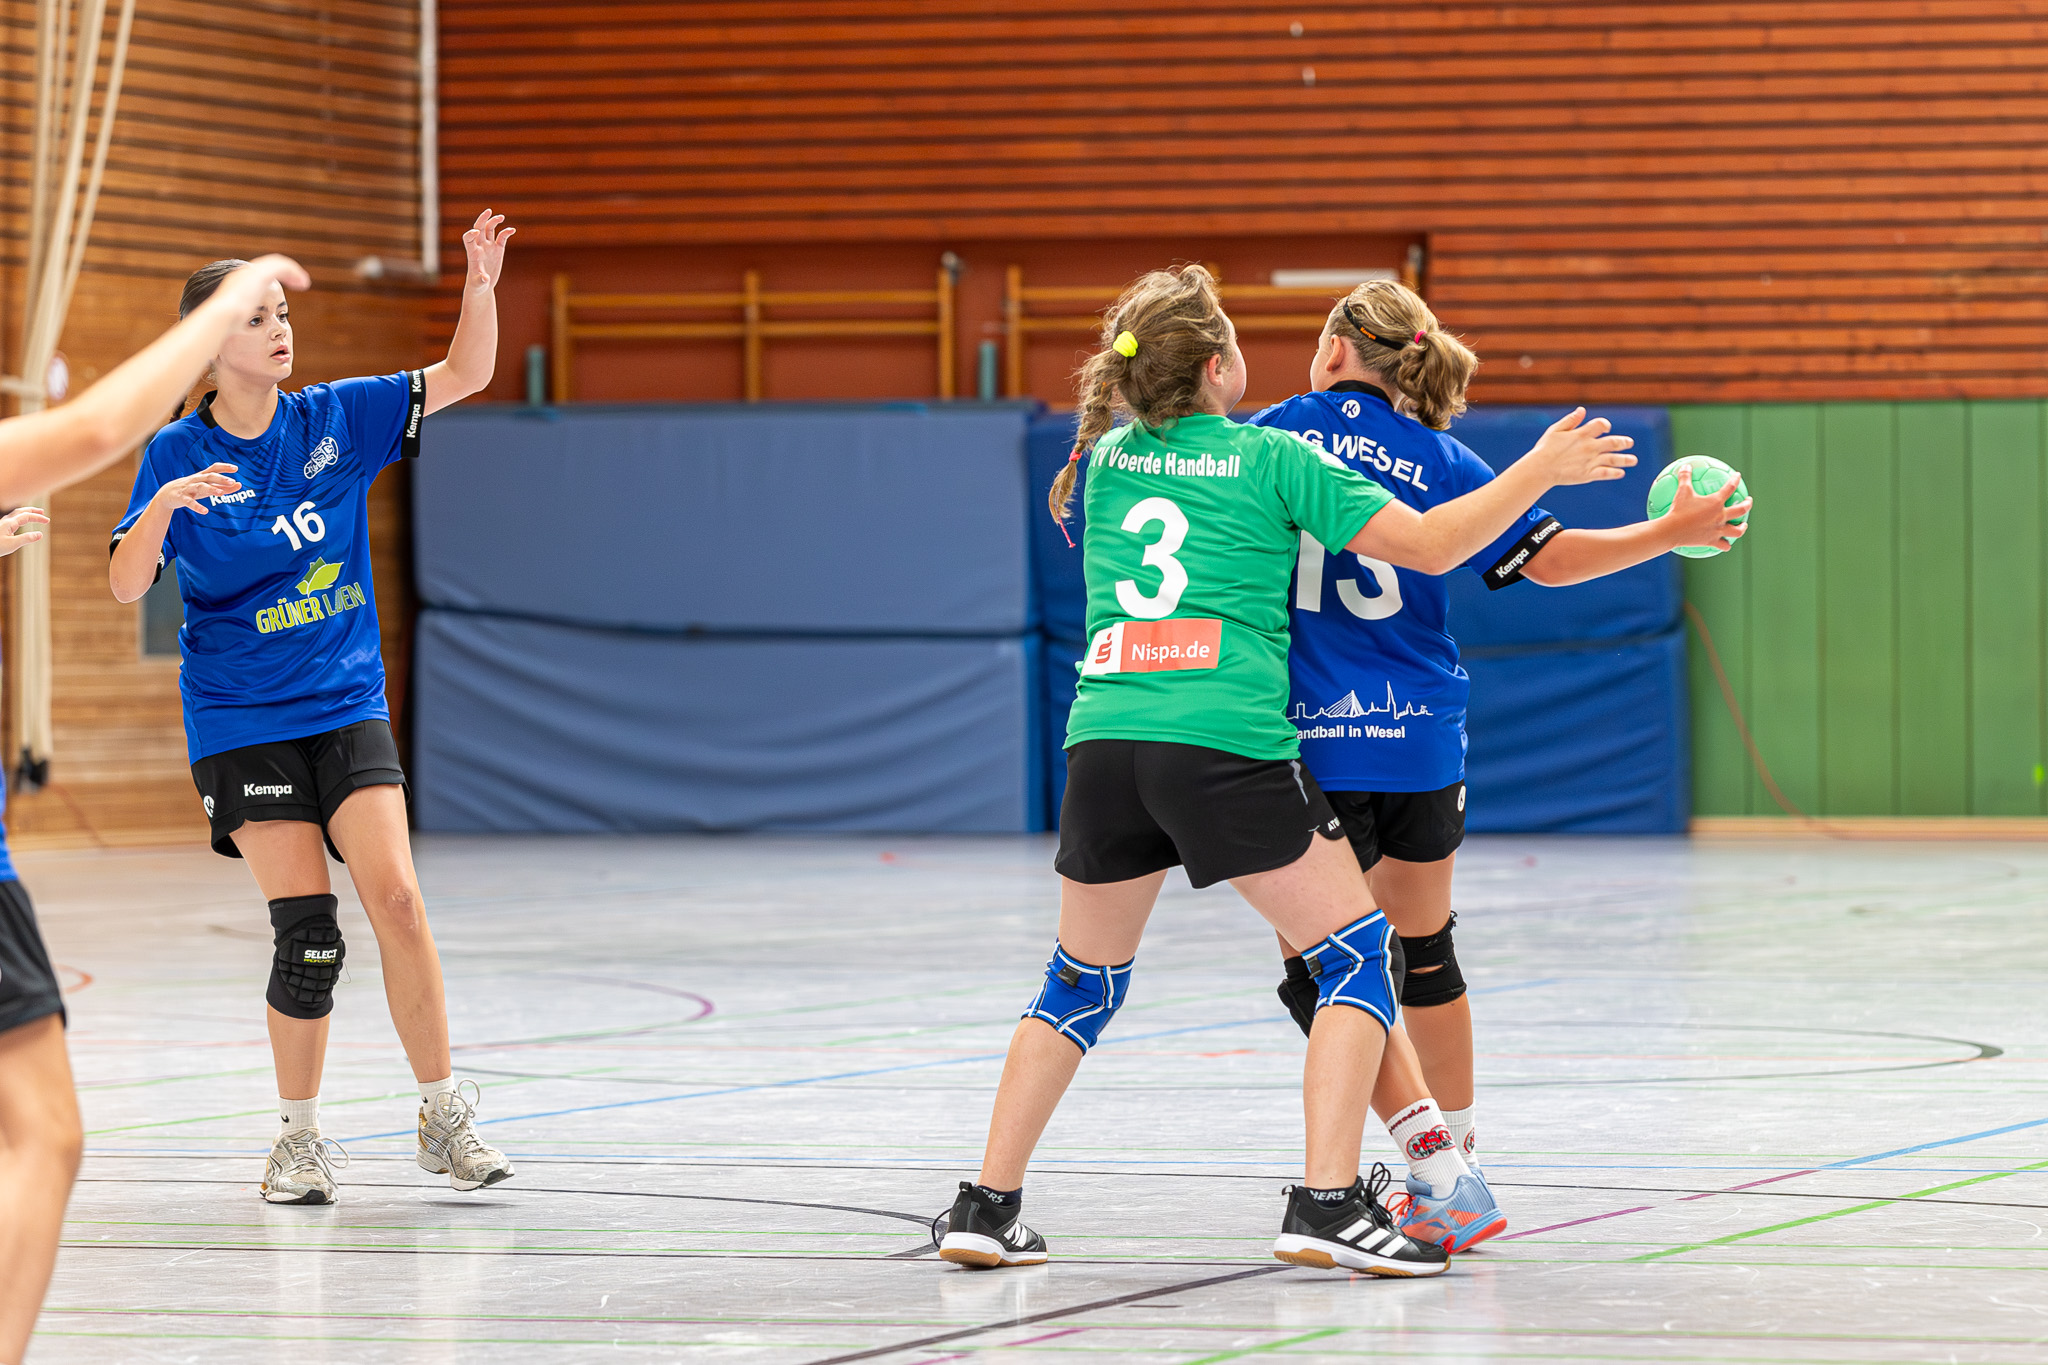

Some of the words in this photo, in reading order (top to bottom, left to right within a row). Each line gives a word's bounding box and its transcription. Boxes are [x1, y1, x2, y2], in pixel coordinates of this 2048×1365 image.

[412, 369, 422, 392] Kemp
[406, 404, 421, 438] Kempa
[1108, 446, 1162, 475] Voerde
[1165, 452, 1241, 477] Handball
[1332, 433, 1429, 492] WESEL
[209, 489, 257, 507] Kempa
[271, 501, 326, 551] 16
[1115, 496, 1190, 619] 3
[1495, 548, 1530, 578] Kempa
[255, 597, 325, 634] GRÜNER
[1131, 640, 1211, 663] Nispa.de
[1296, 725, 1345, 740] andball
[1348, 725, 1362, 738] in
[1364, 725, 1406, 739] Wesel
[243, 783, 293, 798] Kempa
[304, 949, 338, 960] SELECT
[1309, 1190, 1346, 1201] HERS
